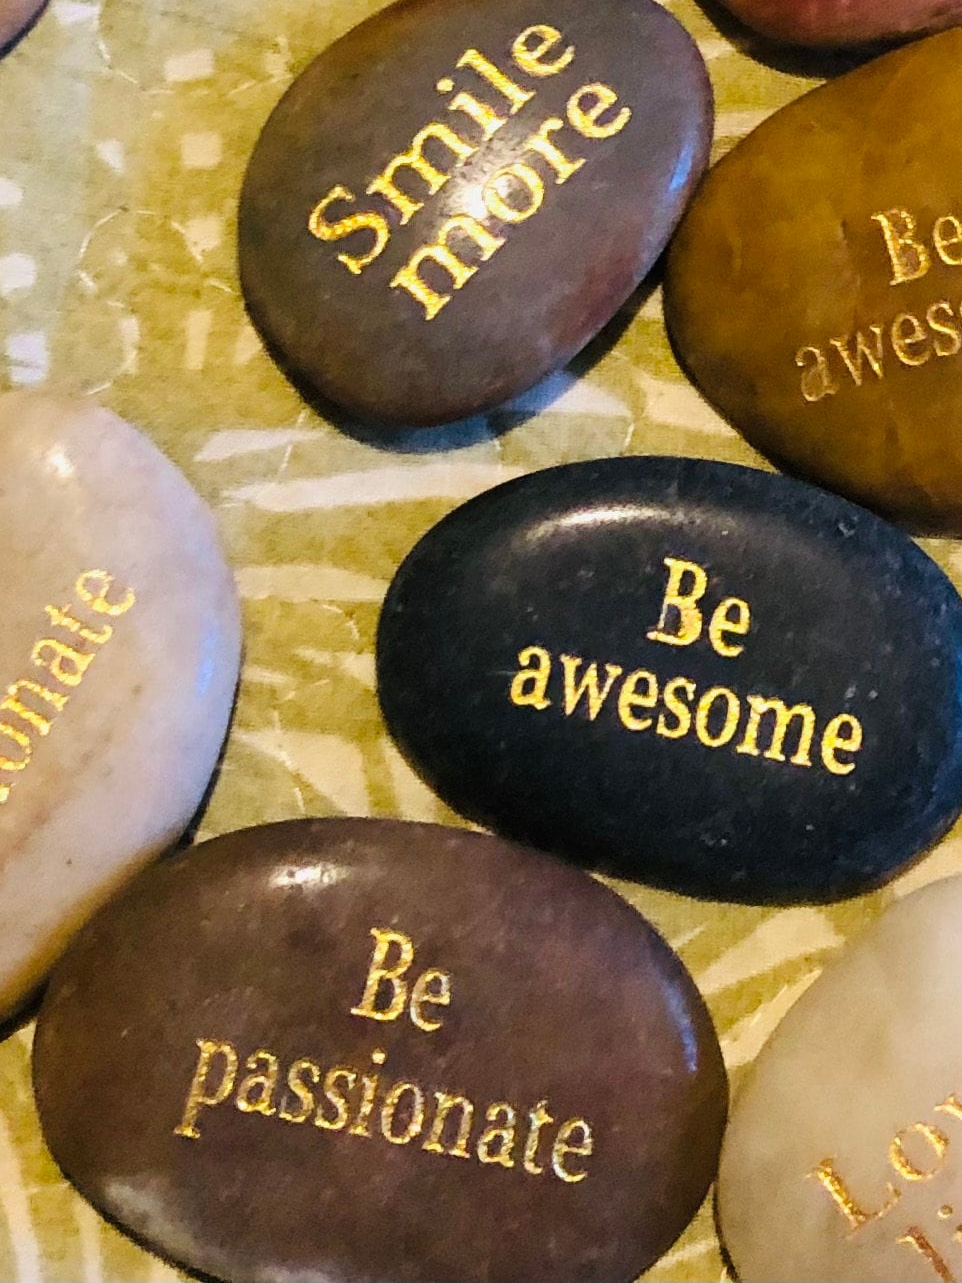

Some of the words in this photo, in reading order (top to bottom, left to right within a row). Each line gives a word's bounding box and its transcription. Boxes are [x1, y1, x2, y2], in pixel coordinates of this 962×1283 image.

[308, 22, 578, 276] Smile
[389, 79, 632, 321] more
[647, 557, 752, 658] Be
[0, 569, 135, 802] onate
[509, 645, 864, 776] awesome
[350, 927, 452, 1032] Be
[173, 1037, 595, 1183] passionate
